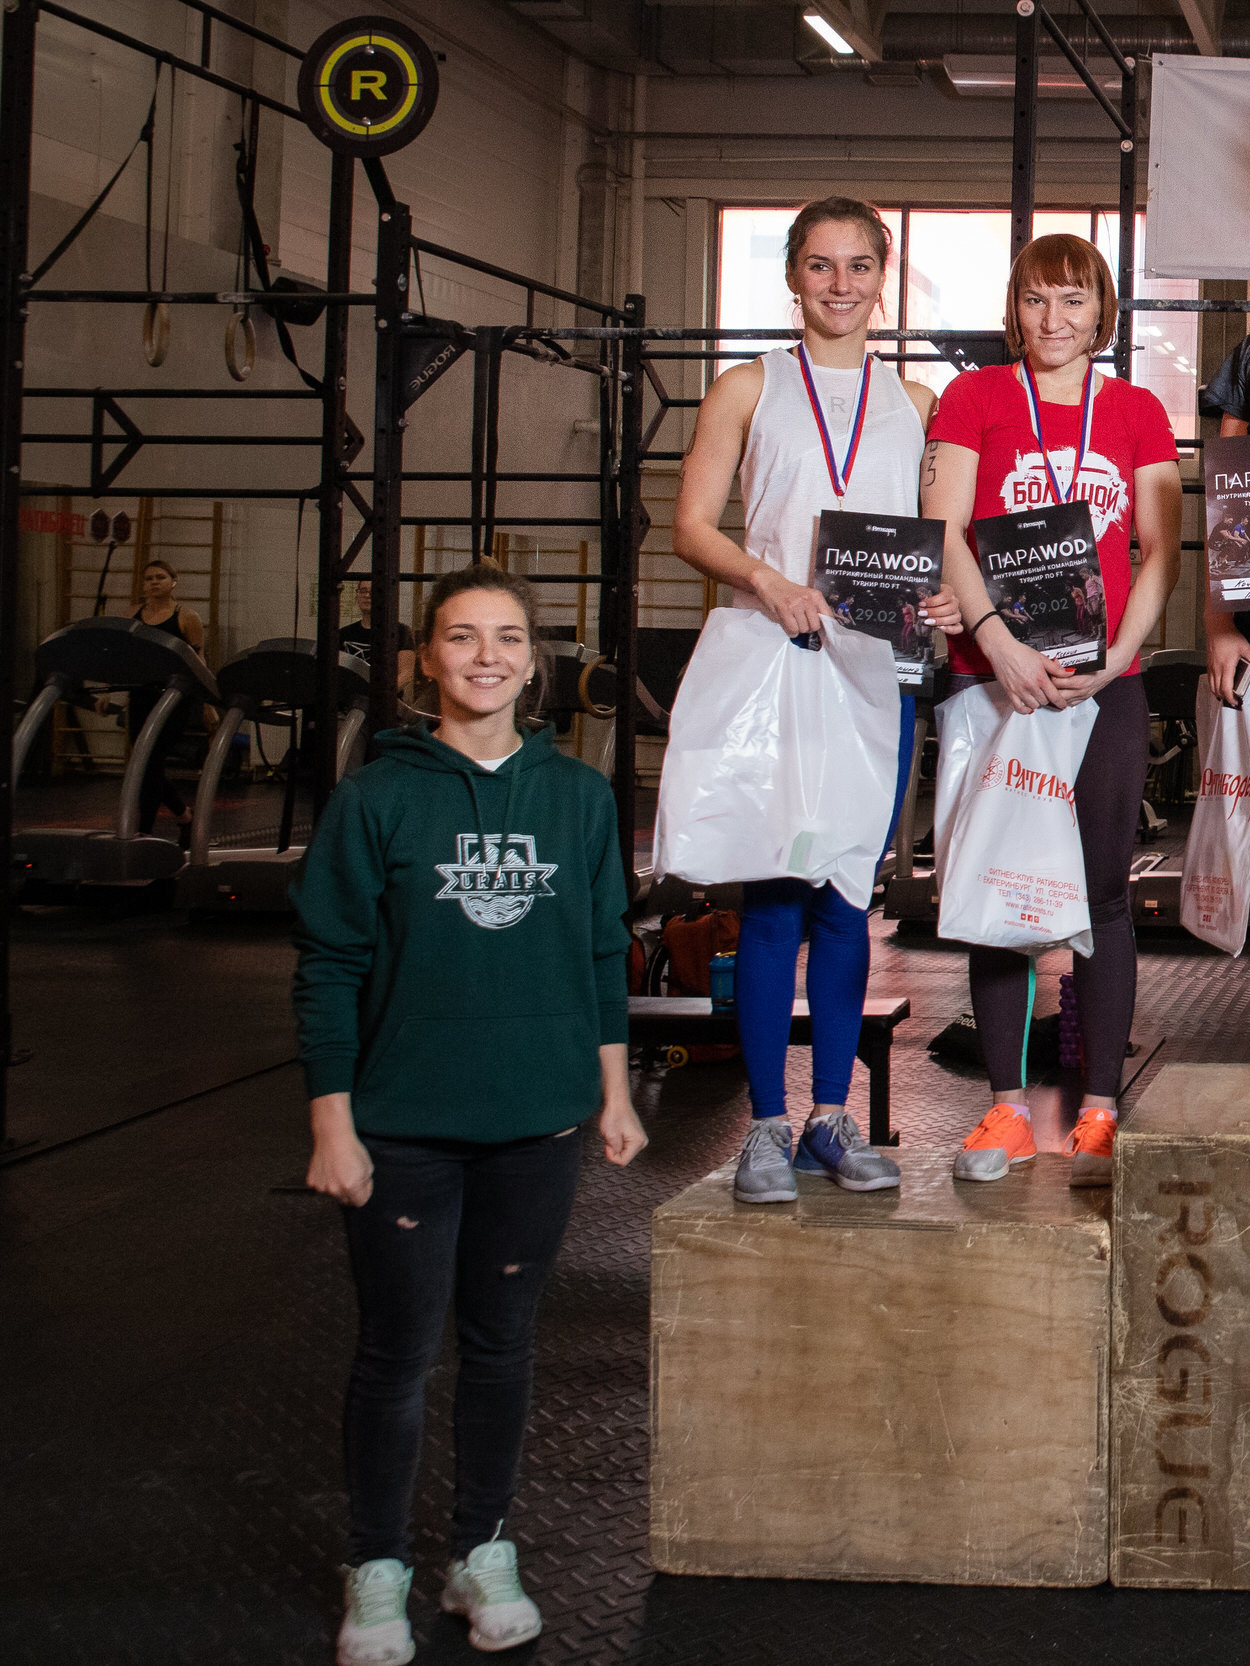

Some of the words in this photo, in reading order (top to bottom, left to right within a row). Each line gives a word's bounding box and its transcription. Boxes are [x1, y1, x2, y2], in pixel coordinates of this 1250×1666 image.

[349, 69, 389, 101] R
[1013, 481, 1120, 513] БОЛШОЙ
[825, 548, 933, 573] ПАРАWOD
[988, 538, 1088, 570] ПАРАWOD
[1047, 557, 1088, 572] КОМАНДНЫЙ
[852, 579, 878, 589] ТУРНИР
[880, 581, 890, 590] ПО
[891, 582, 900, 590] FT
[885, 573, 929, 584] КОМАНДНЫЙ
[1019, 574, 1042, 585] ТУРНИР
[1043, 572, 1053, 581] ПО
[855, 608, 898, 624] 29.02
[1031, 598, 1070, 616] 29.02
[459, 872, 538, 890] URALS
[989, 867, 1034, 884] ФИТНЕС-КЛУБ
[1036, 877, 1080, 892] РАТИБОРЕЦ
[1155, 1180, 1215, 1544] ROGUE
